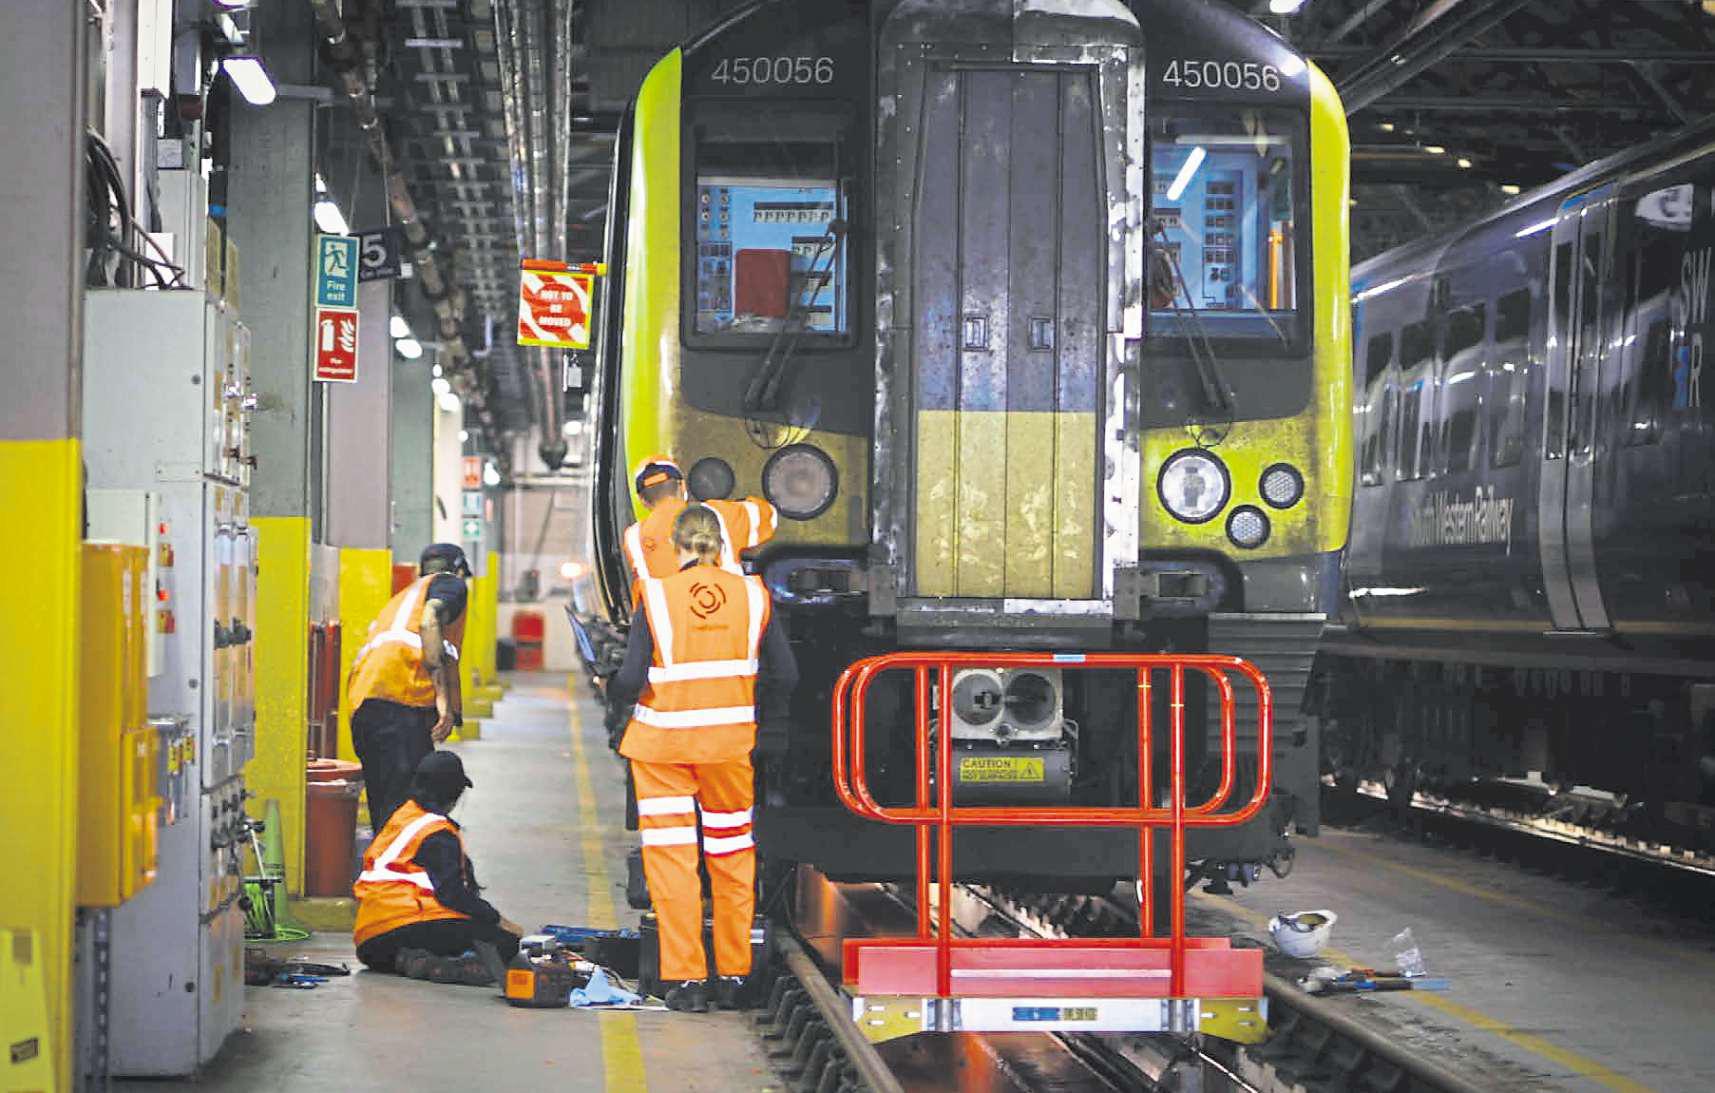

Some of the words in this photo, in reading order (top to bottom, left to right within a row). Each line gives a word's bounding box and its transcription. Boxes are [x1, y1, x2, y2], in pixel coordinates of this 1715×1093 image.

[711, 57, 834, 84] 450056
[1162, 60, 1280, 91] 450056
[361, 234, 387, 268] 5
[326, 280, 346, 290] Fire
[326, 292, 346, 301] exit
[1679, 247, 1711, 327] SW
[1474, 485, 1513, 557] Railway
[962, 758, 1011, 769] CAUTION
